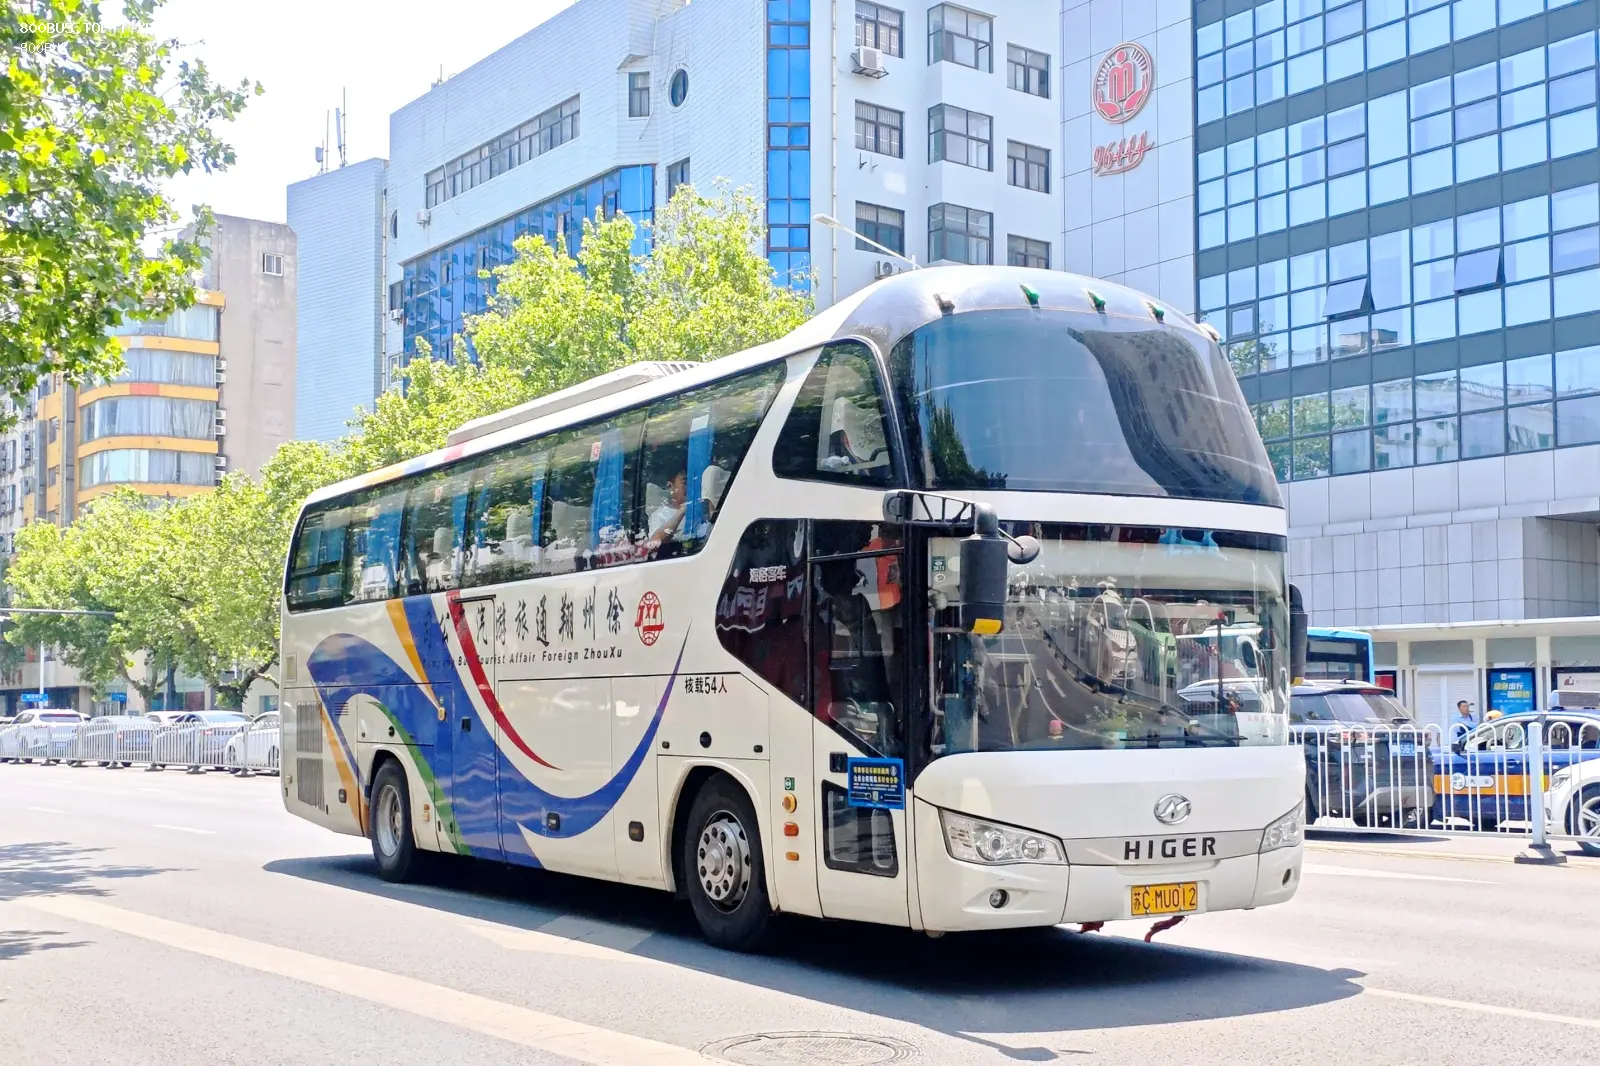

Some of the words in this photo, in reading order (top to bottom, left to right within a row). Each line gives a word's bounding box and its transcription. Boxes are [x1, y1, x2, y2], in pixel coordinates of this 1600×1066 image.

[1094, 131, 1154, 174] 96444
[509, 652, 536, 664] Affair
[541, 650, 579, 663] Foreign
[584, 646, 622, 660] ZhouXu
[684, 675, 728, 695] 核载54人
[1124, 836, 1216, 860] HIGER
